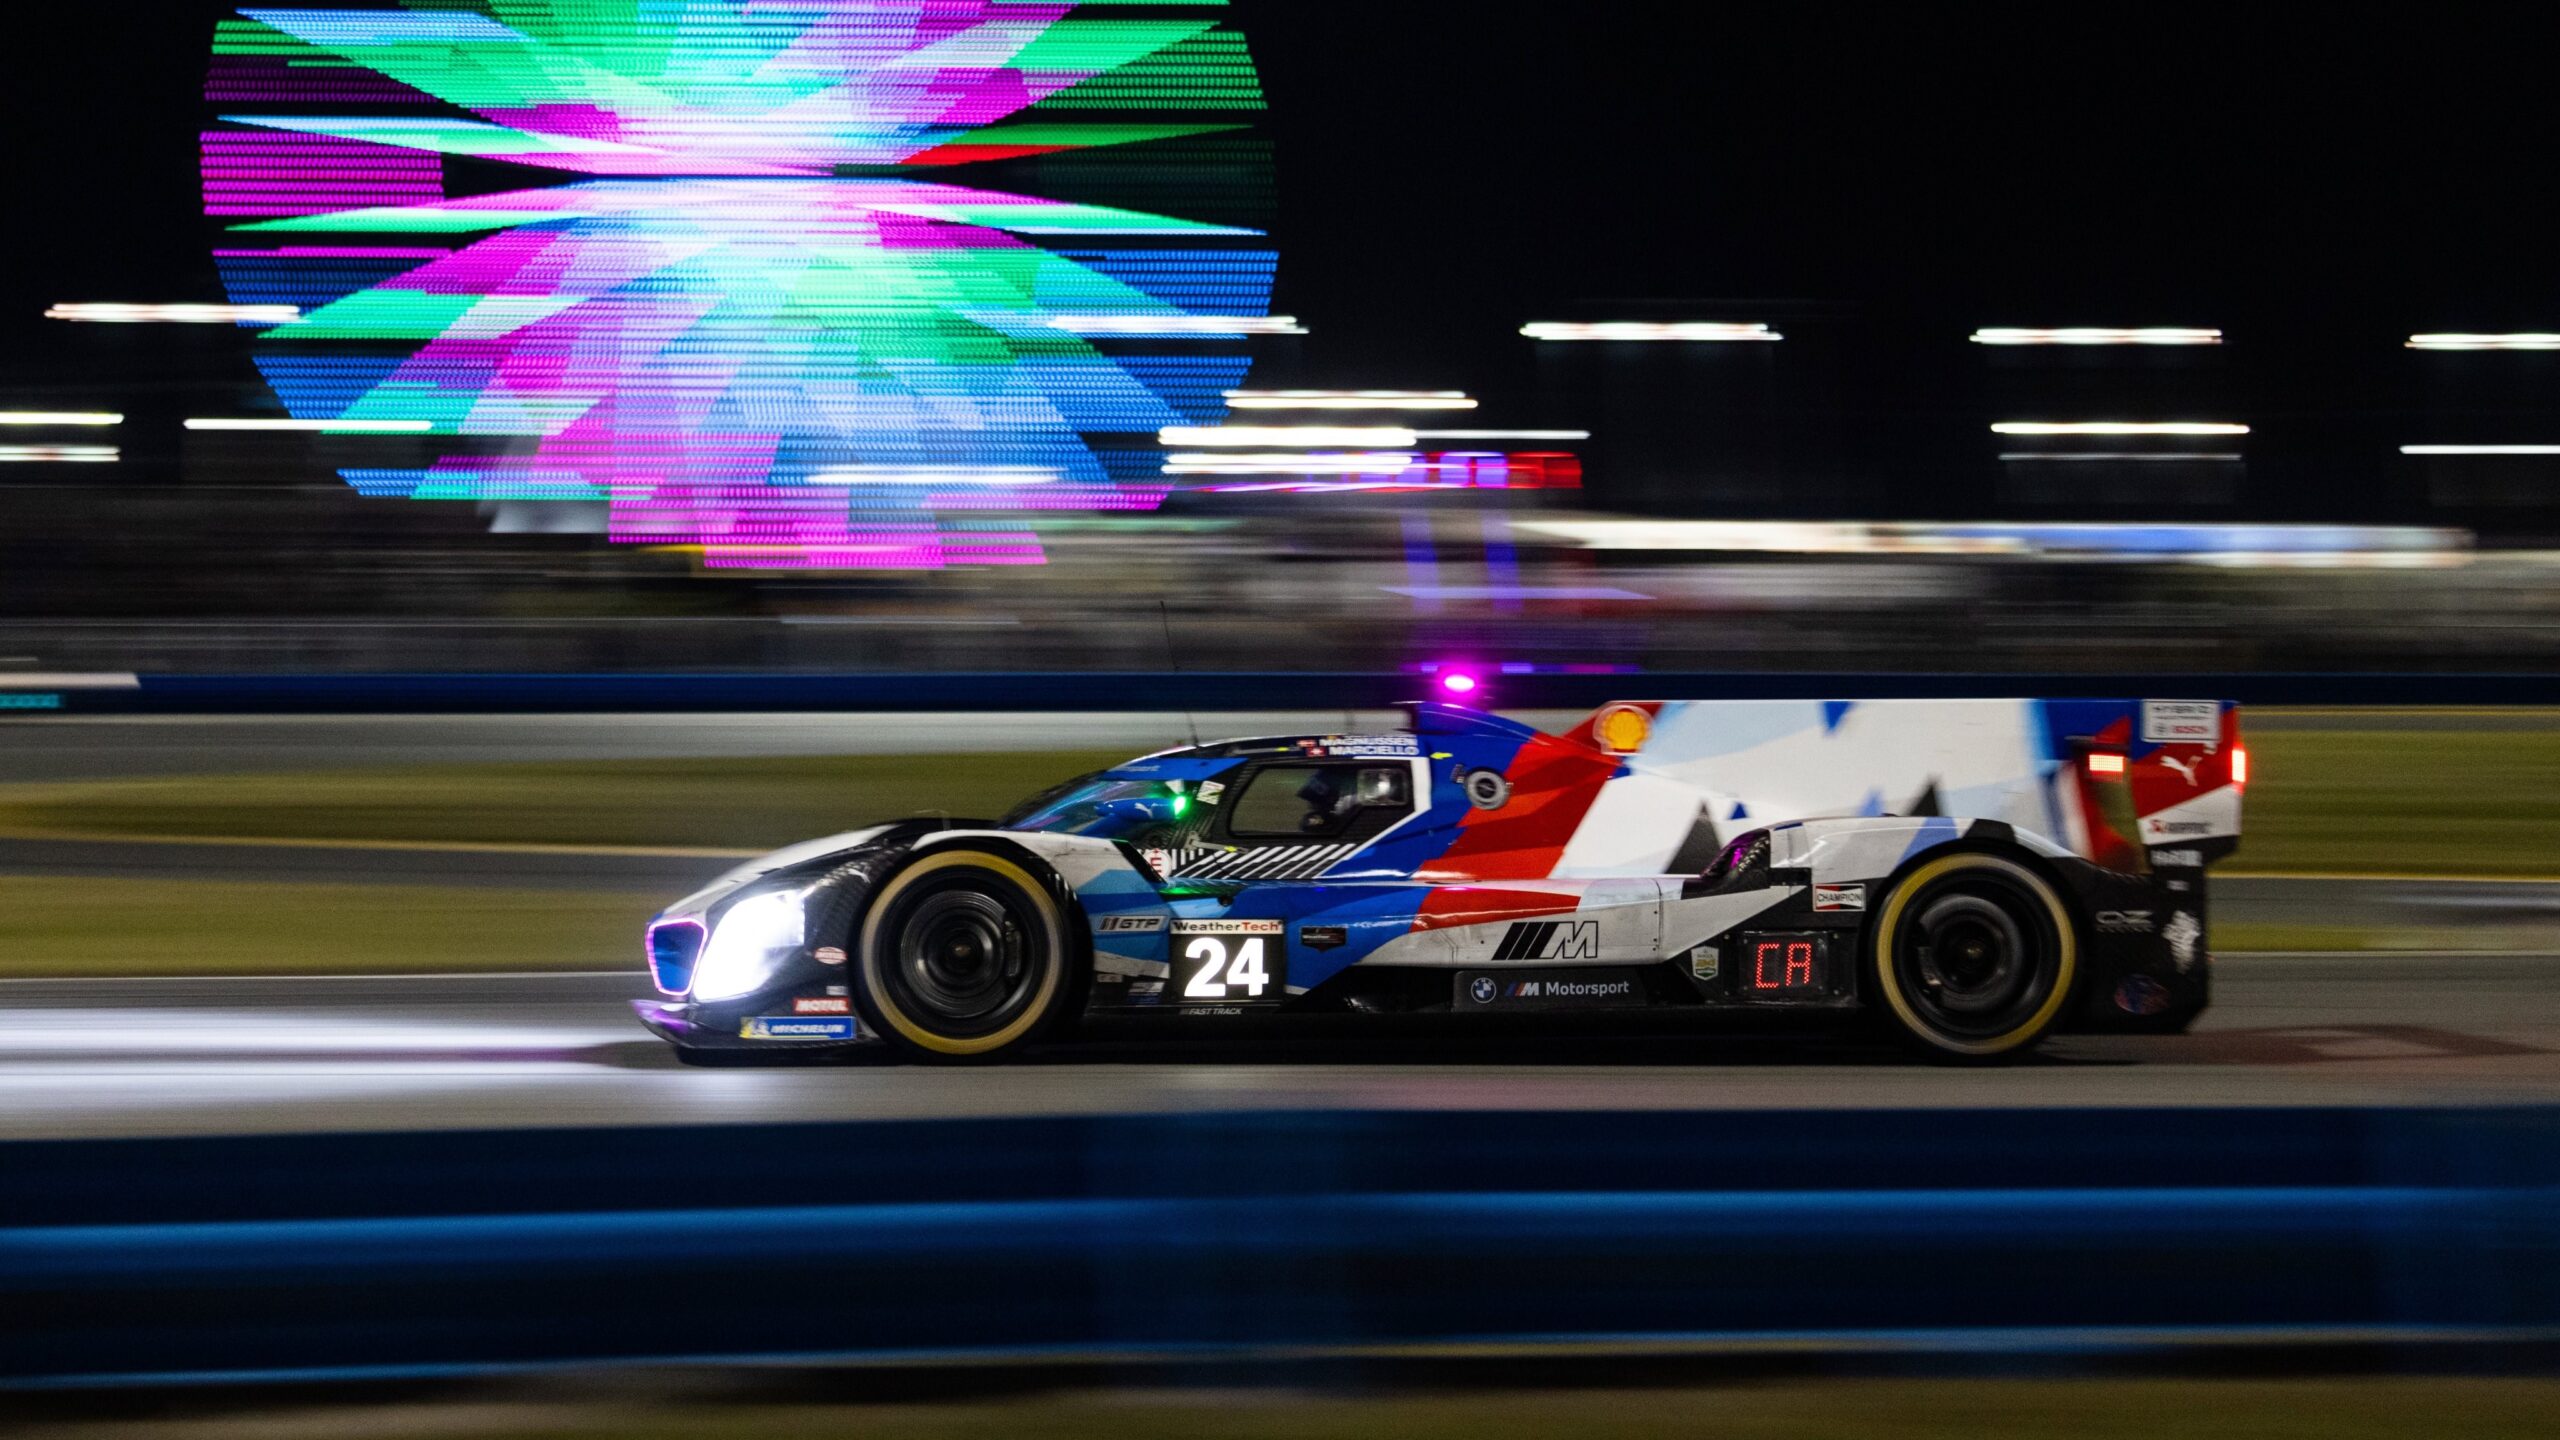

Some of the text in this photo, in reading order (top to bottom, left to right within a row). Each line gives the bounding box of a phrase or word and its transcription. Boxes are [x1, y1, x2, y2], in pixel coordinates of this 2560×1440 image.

[1817, 892, 1862, 902] CHAMPION
[1119, 918, 1160, 929] GTP
[1184, 937, 1269, 997] 24
[1755, 943, 1812, 989] CA
[1546, 981, 1630, 997] Motorsport
[1188, 1007, 1242, 1015] FAST TRACK
